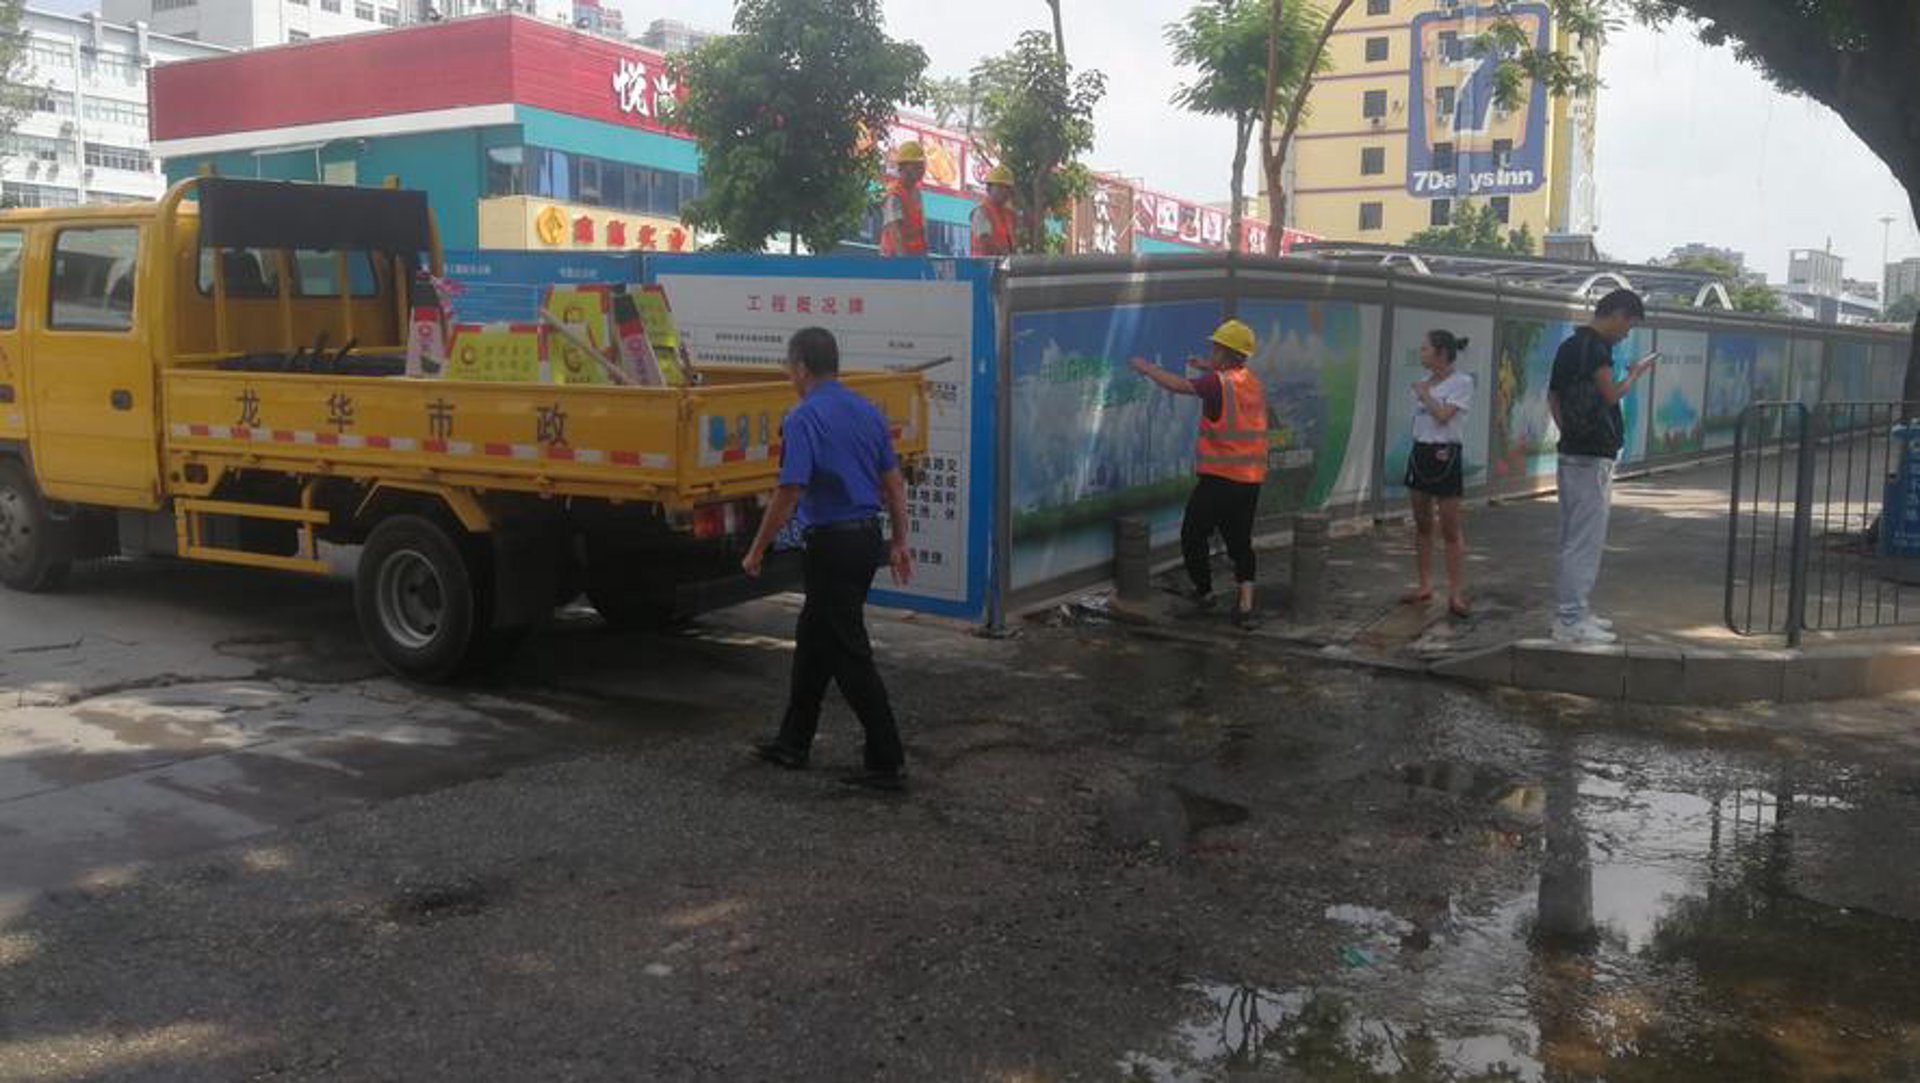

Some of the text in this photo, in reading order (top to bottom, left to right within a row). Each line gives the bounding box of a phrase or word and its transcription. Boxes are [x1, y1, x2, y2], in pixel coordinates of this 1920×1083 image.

[1496, 168, 1534, 187] Inn
[235, 389, 568, 446] 龙华市政
